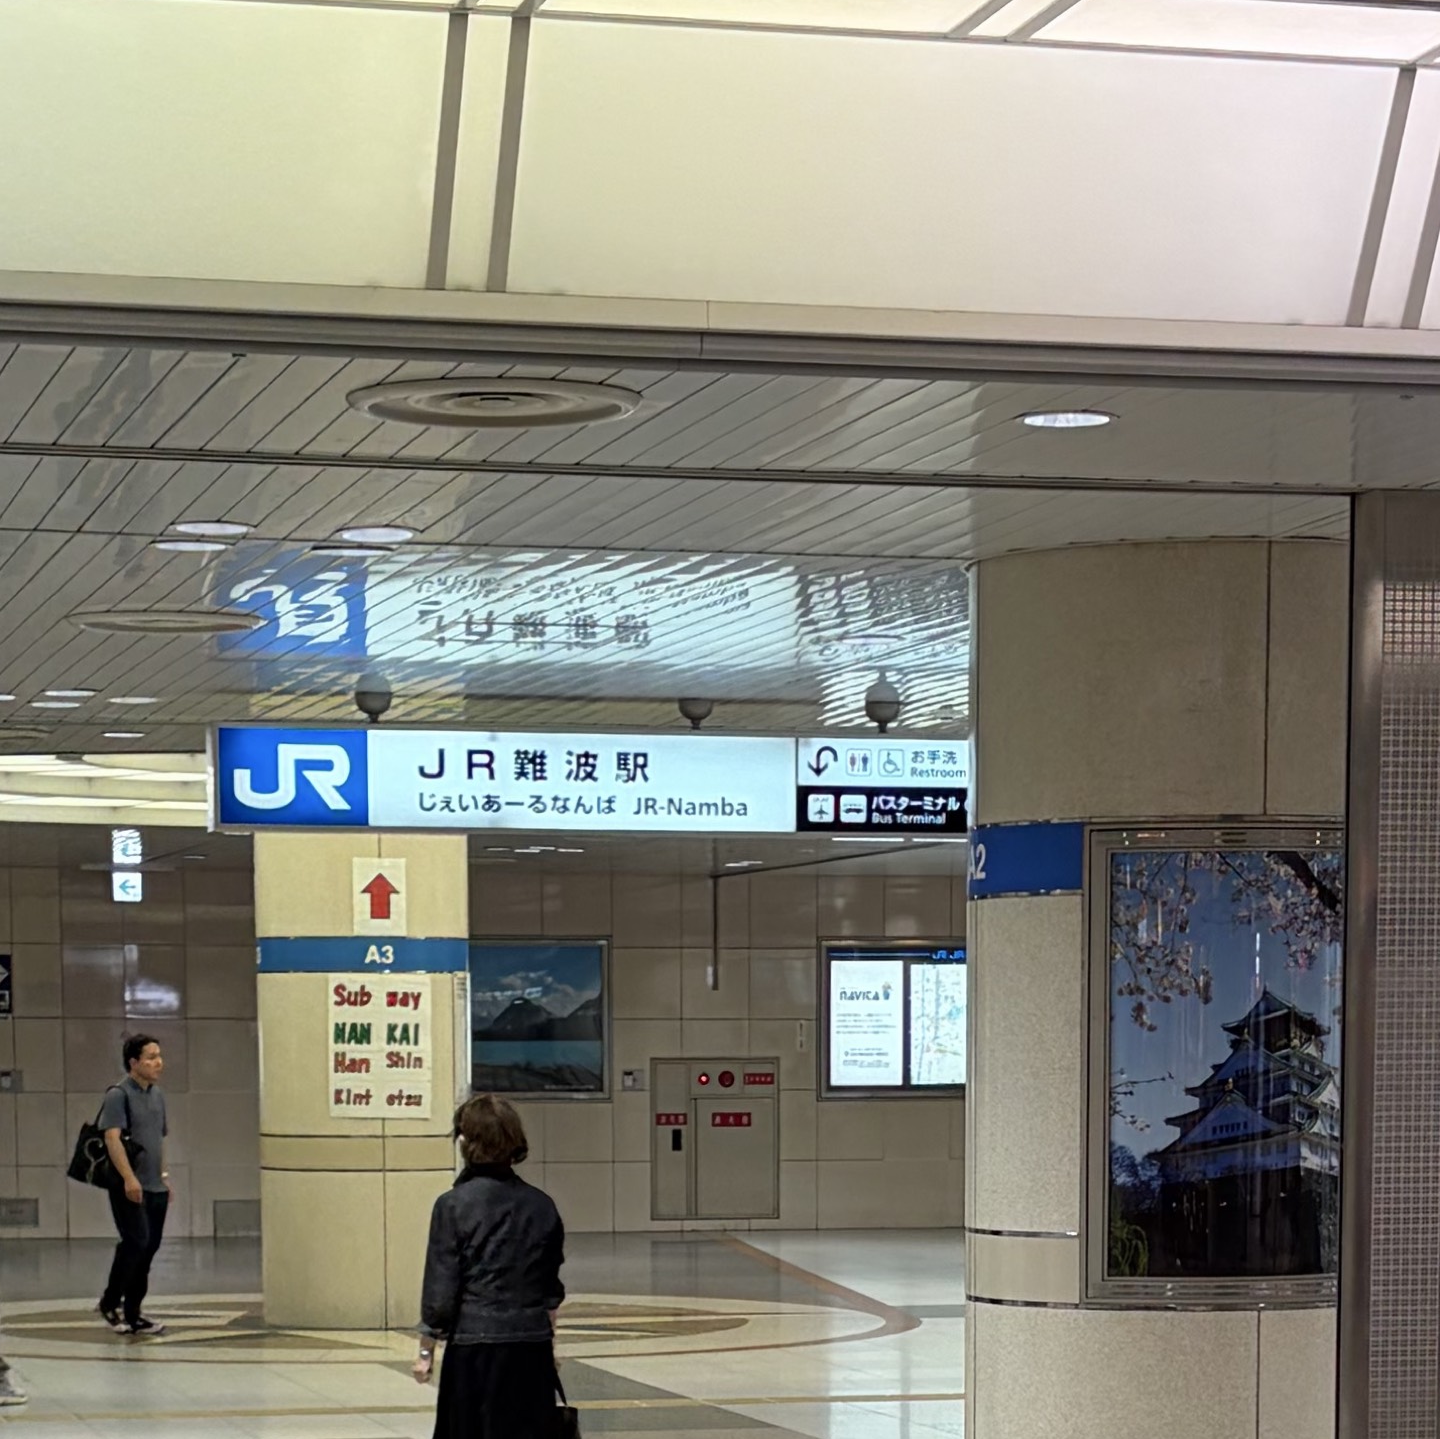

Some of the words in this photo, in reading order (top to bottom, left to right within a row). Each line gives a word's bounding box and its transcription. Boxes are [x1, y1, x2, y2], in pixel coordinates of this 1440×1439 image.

[418, 748, 650, 784] JR難波駅
[910, 749, 958, 765] お手洗
[233, 743, 352, 811] JR
[418, 792, 617, 816] じぇいあーるなんば
[633, 795, 748, 818] JR-Namba
[871, 812, 893, 824] Bus
[896, 812, 946, 825] Terminal
[364, 945, 395, 964] A3
[333, 983, 373, 1006] Sub
[333, 1022, 372, 1045] NAN
[386, 1022, 420, 1046] KAI
[333, 1052, 371, 1073] Han
[386, 1051, 423, 1069] Shin
